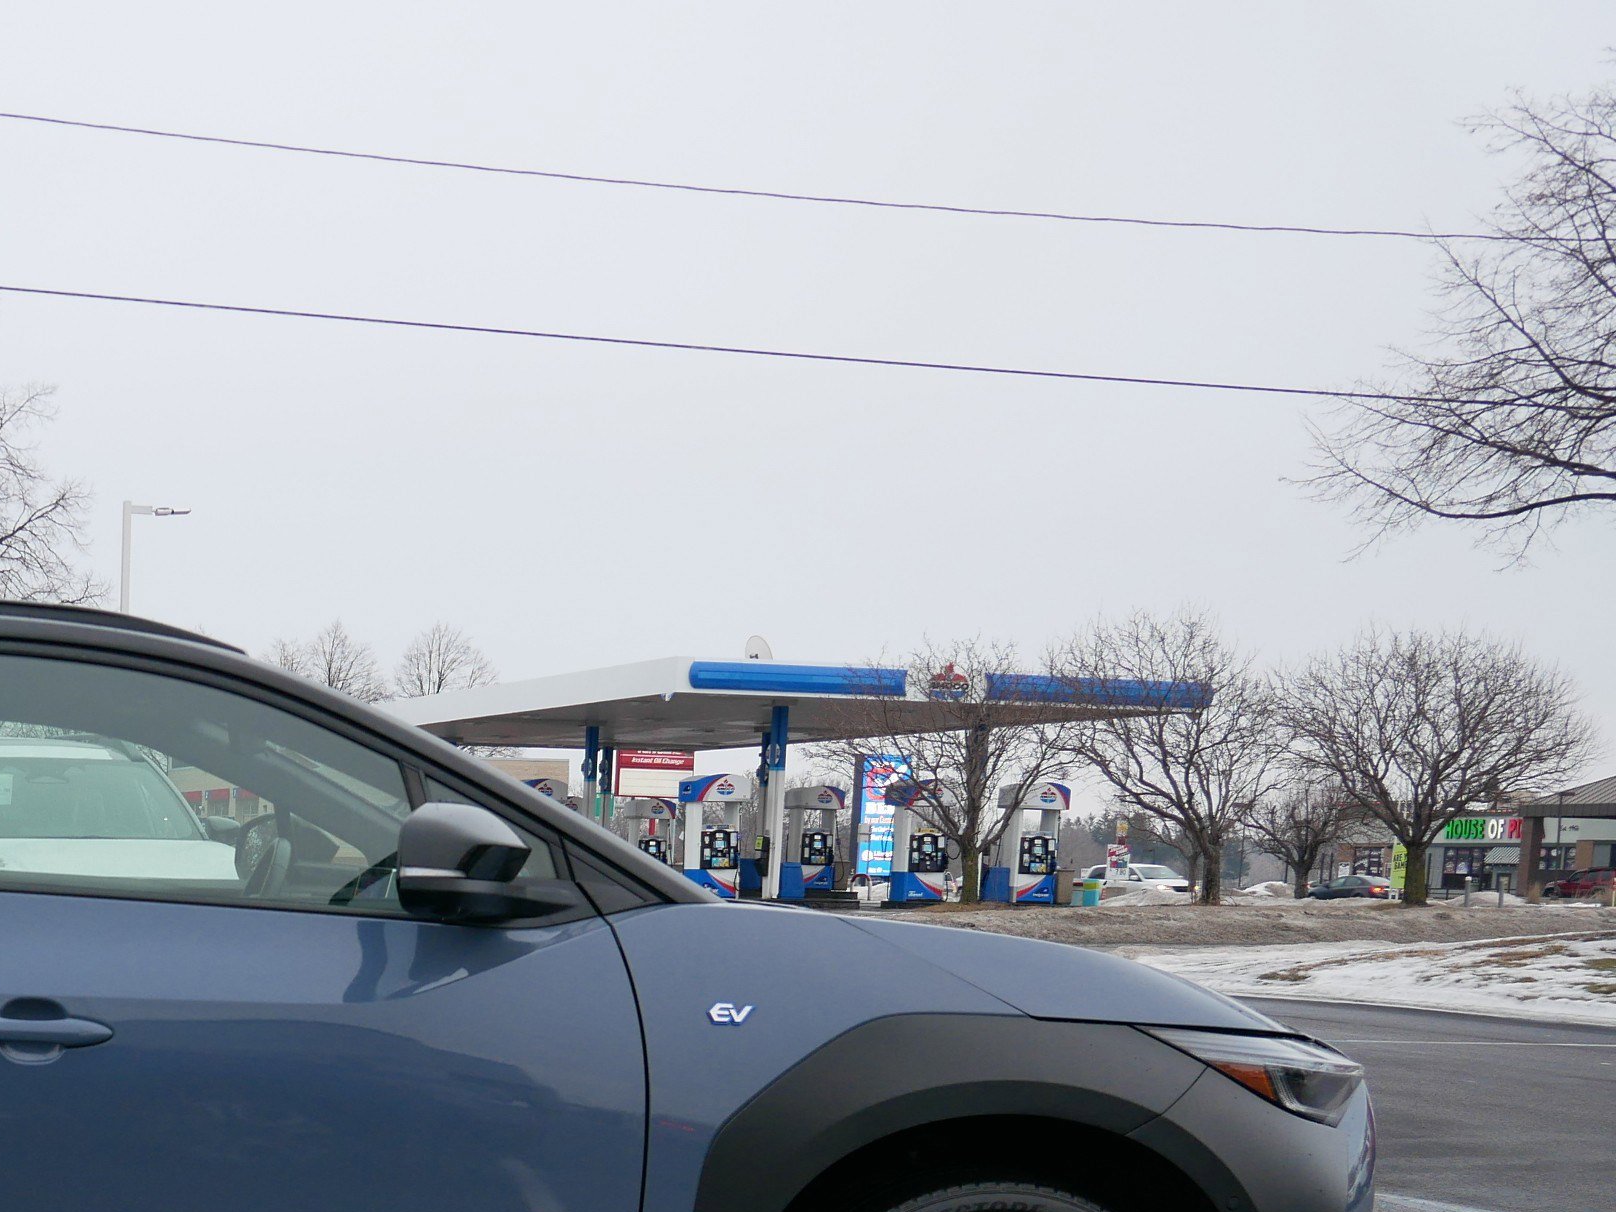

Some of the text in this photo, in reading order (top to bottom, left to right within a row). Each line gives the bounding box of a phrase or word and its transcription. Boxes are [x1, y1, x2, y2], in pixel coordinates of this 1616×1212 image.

[1445, 818, 1486, 839] HOUSE
[1488, 818, 1505, 839] OF
[707, 1002, 753, 1024] EV
